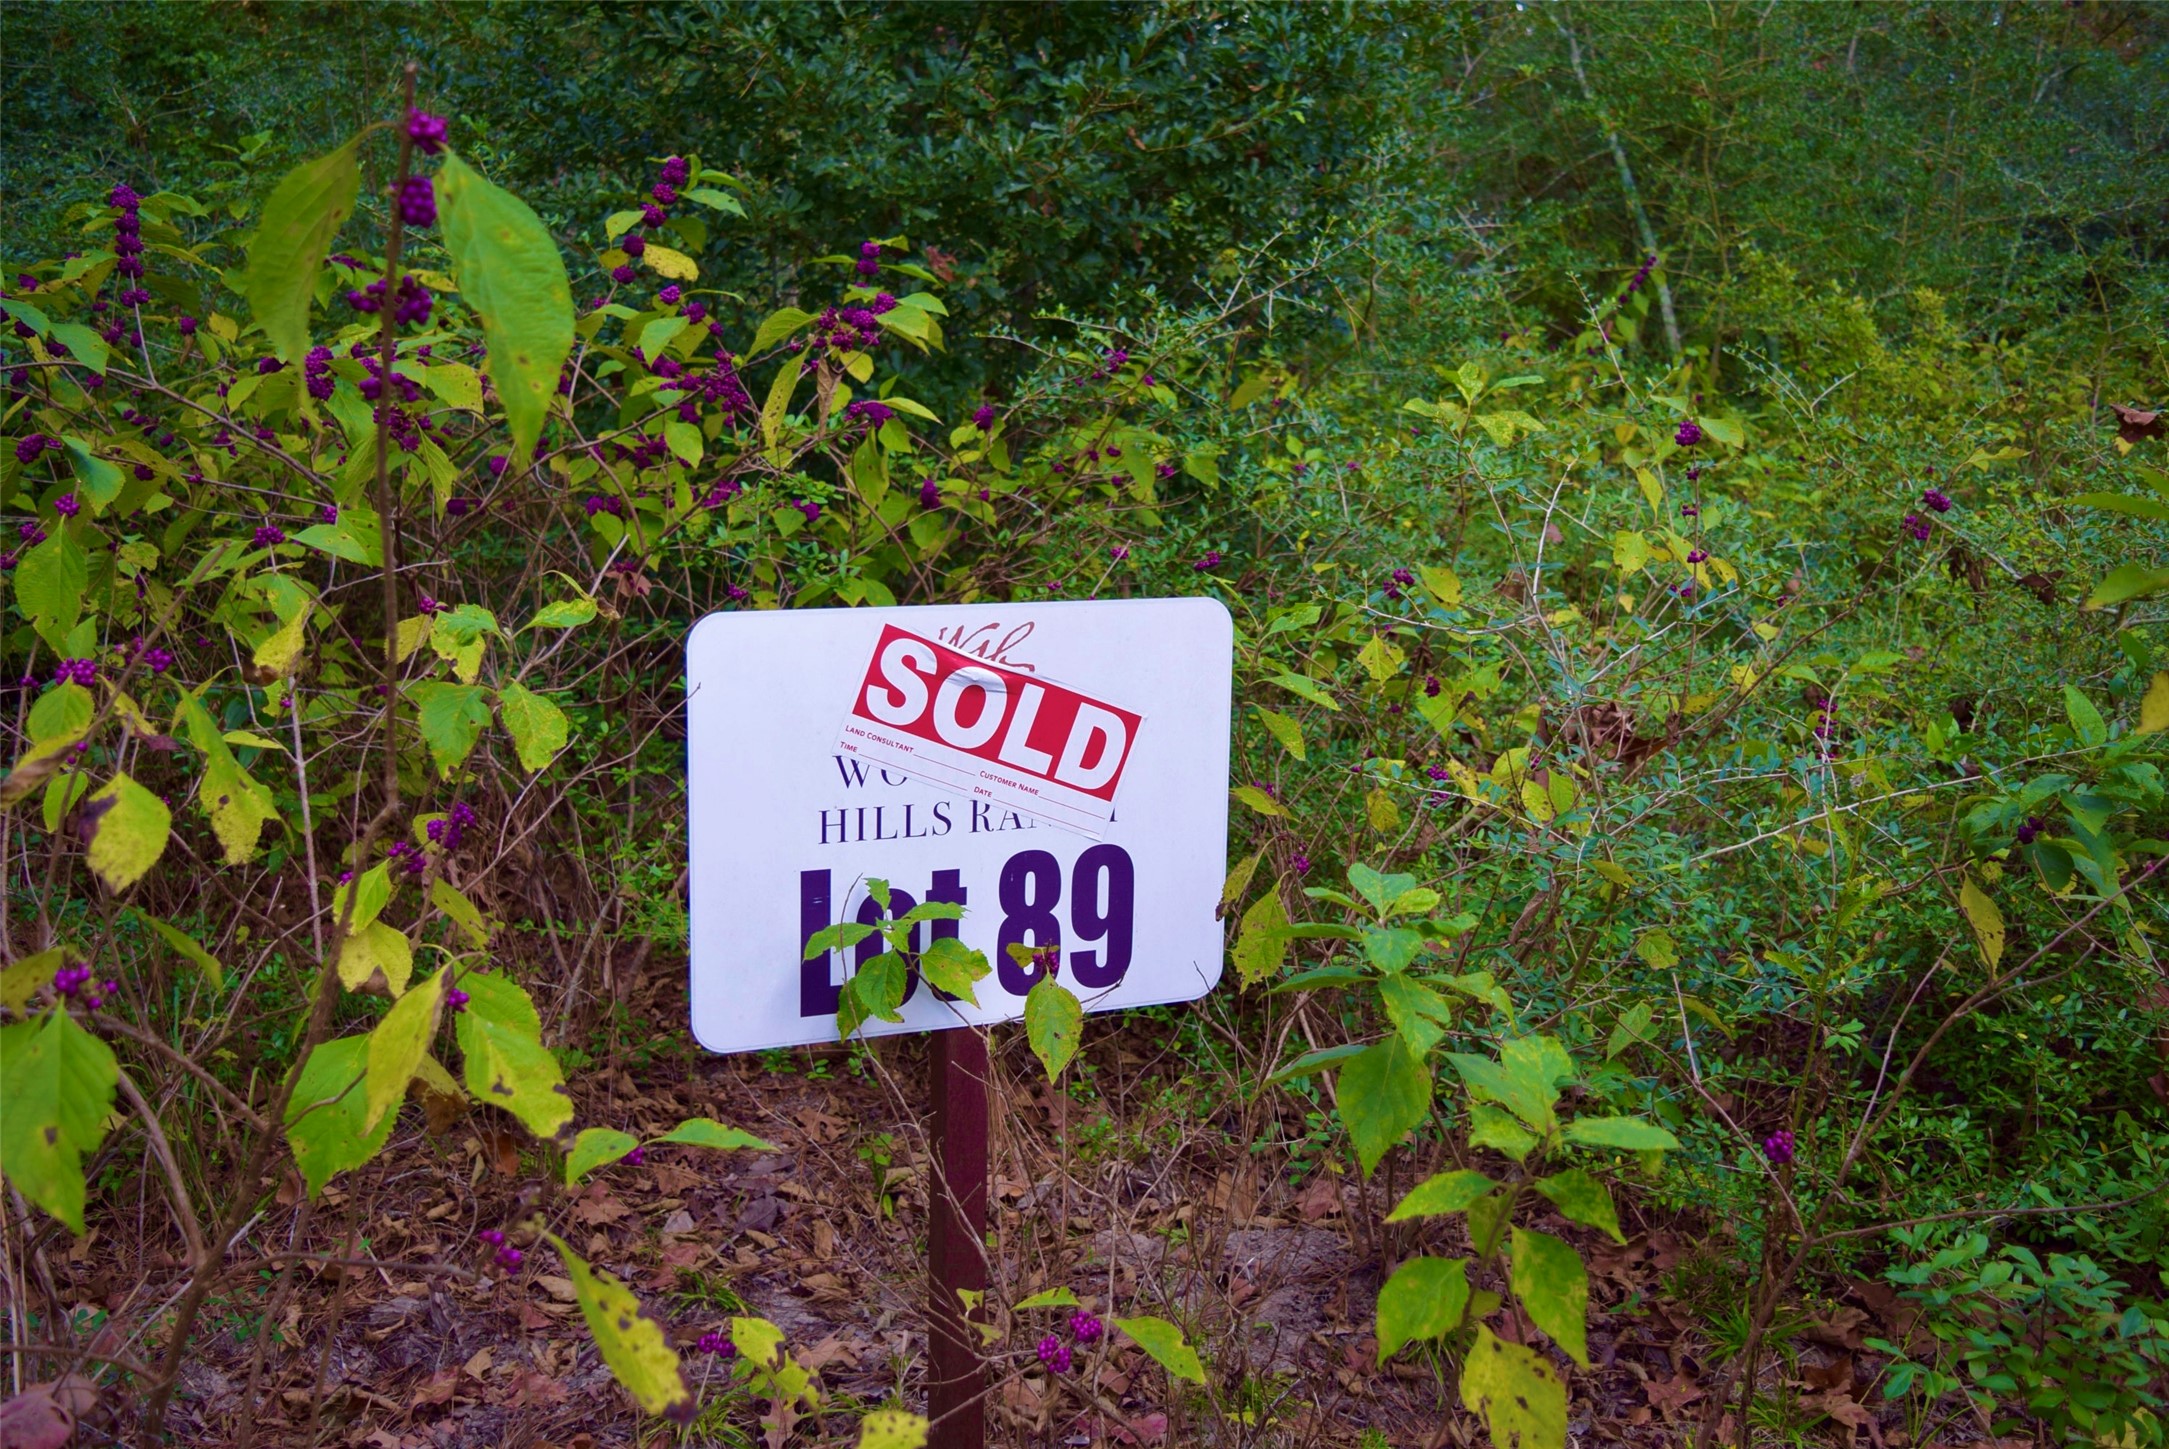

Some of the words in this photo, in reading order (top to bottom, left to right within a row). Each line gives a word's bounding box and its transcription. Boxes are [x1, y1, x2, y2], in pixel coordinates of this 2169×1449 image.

[866, 637, 1127, 790] SOLD
[840, 741, 858, 753] TIME
[845, 725, 866, 737] LAND
[866, 732, 915, 753] CONSULTANT
[973, 786, 993, 798] DATE
[979, 770, 1017, 788] CUSTOMER
[1018, 783, 1040, 796] NAME
[818, 801, 951, 844] HILLS
[996, 843, 1135, 997] 89
